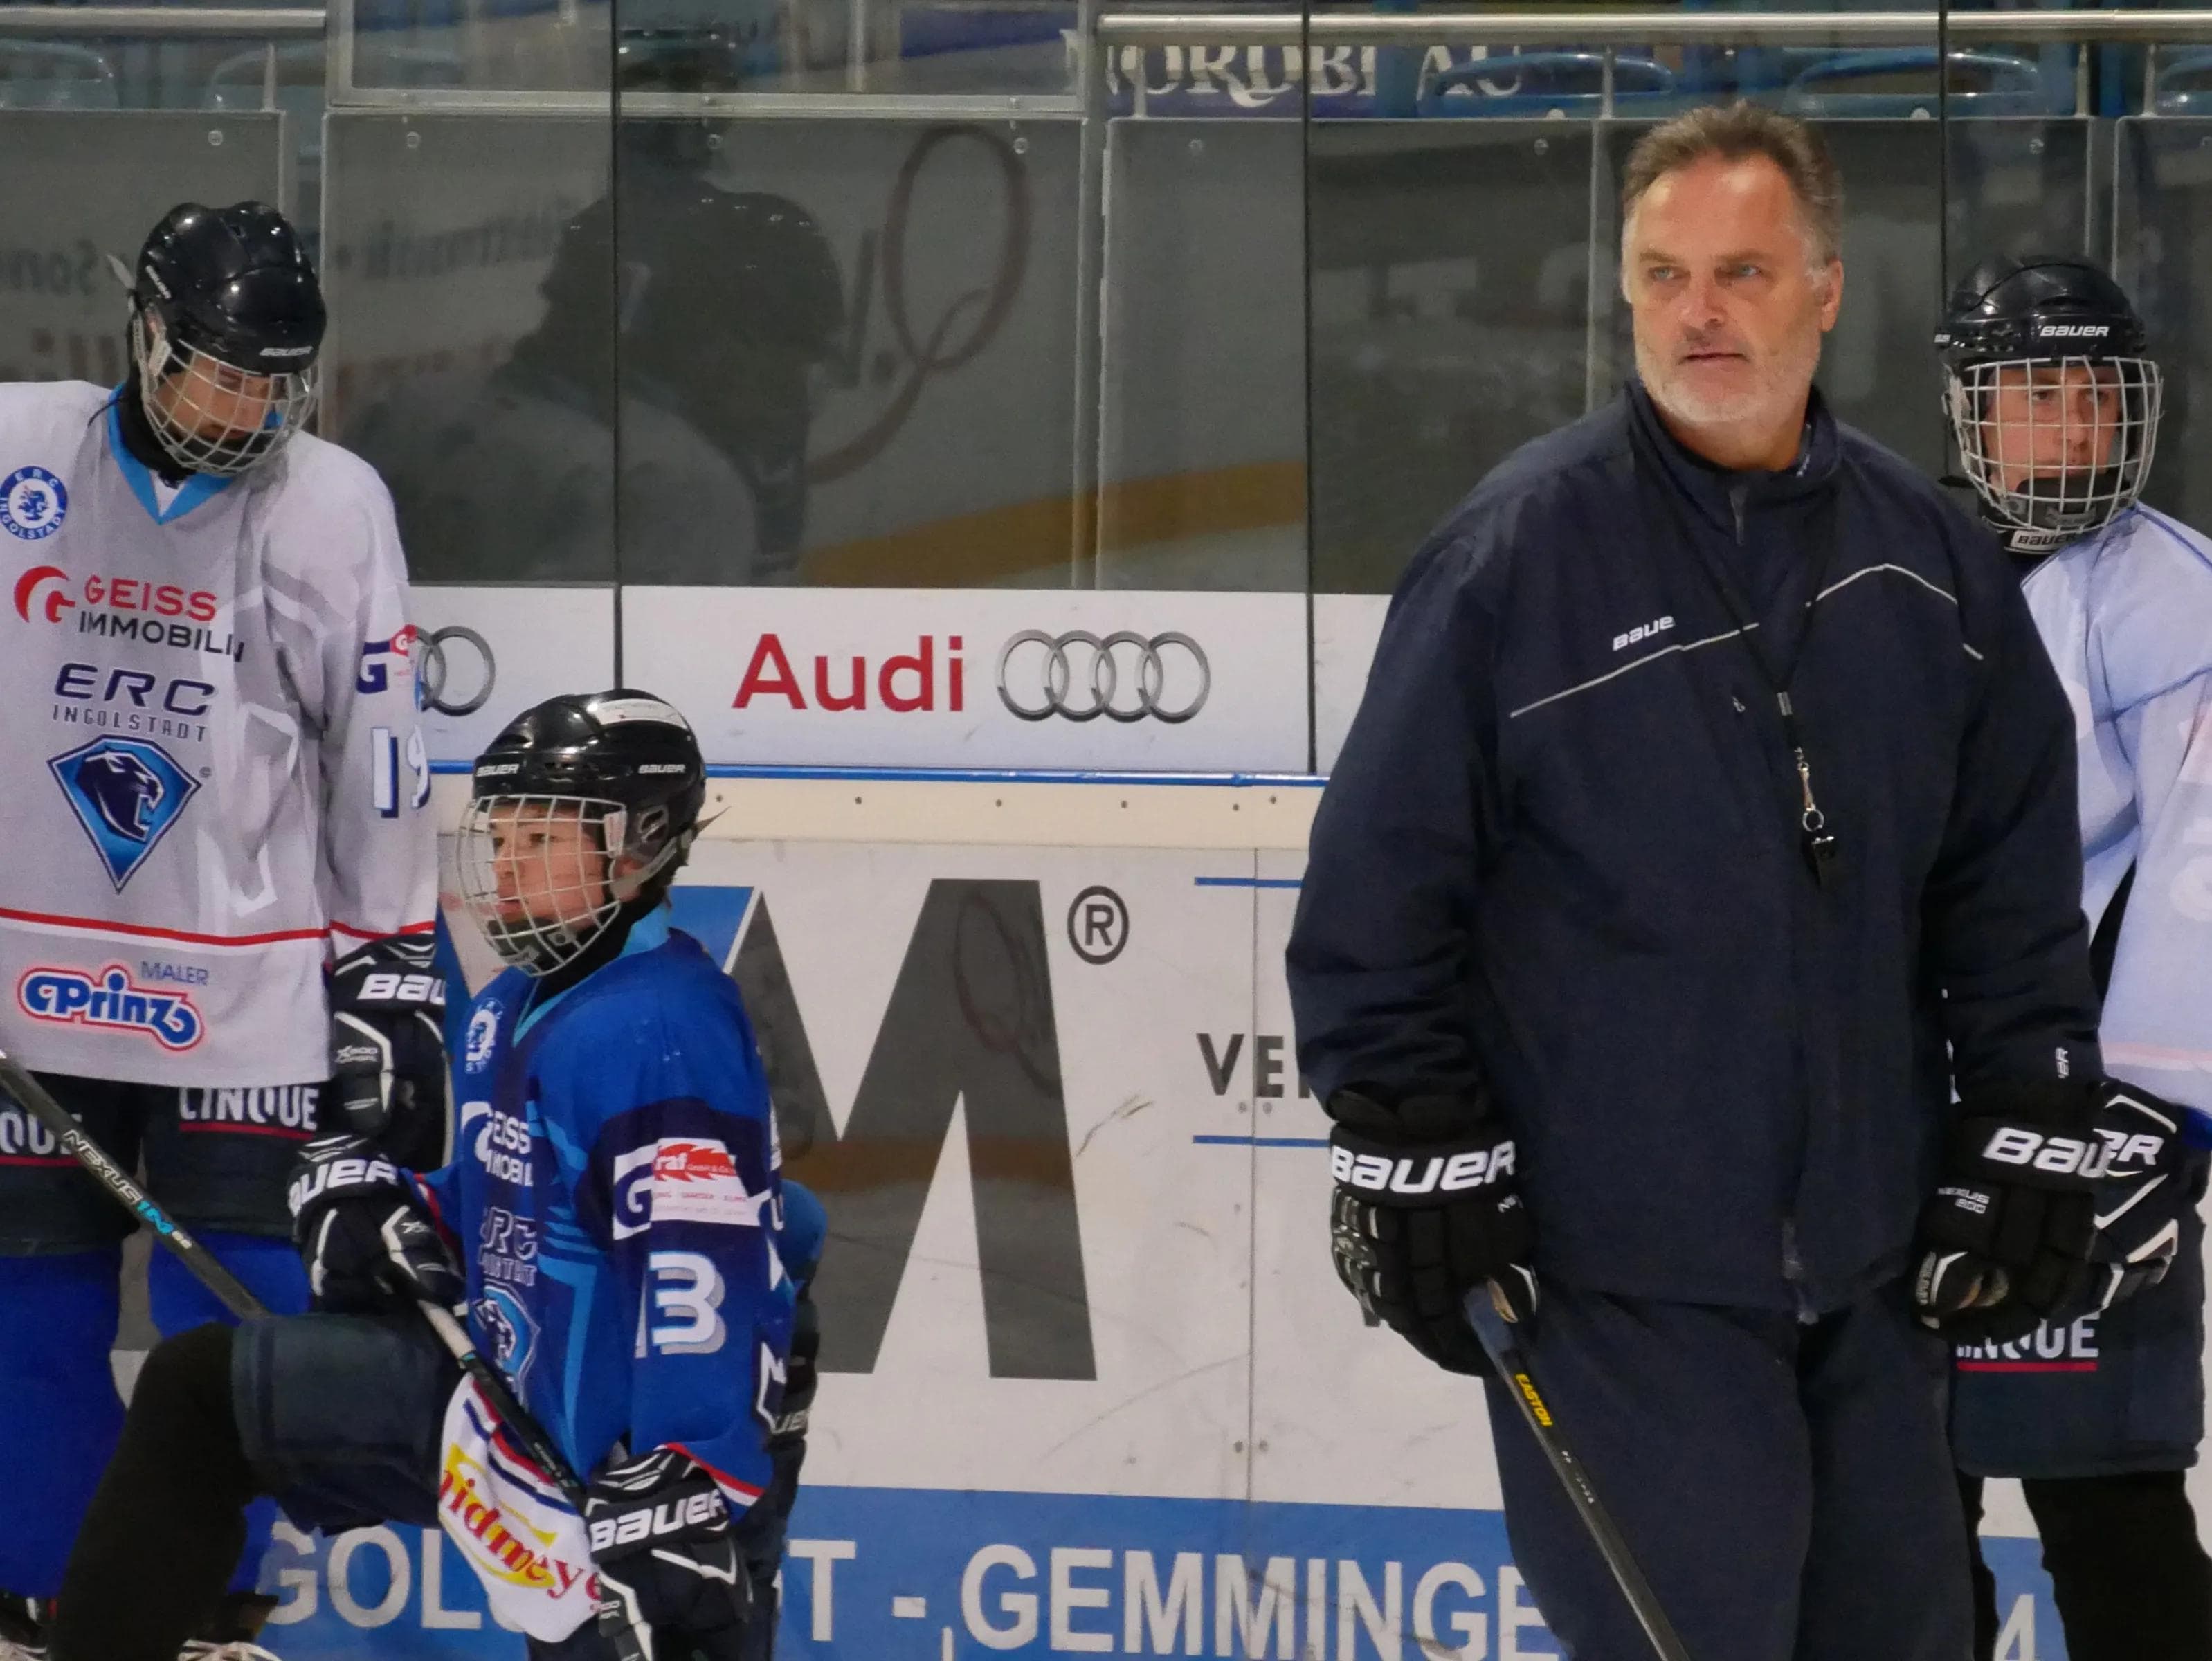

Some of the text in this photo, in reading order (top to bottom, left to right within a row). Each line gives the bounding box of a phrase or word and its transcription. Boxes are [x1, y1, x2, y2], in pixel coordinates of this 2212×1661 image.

[2040, 325, 2110, 338] BAUER
[84, 574, 217, 621] GEISS
[55, 662, 215, 716] ERC
[732, 633, 963, 712] Audi
[52, 705, 206, 743] INGOLSTADT
[638, 763, 685, 774] BAUER
[140, 960, 208, 986] MALER
[1331, 1140, 1516, 1193] BAUER
[1515, 1374, 1553, 1427] EASTON
